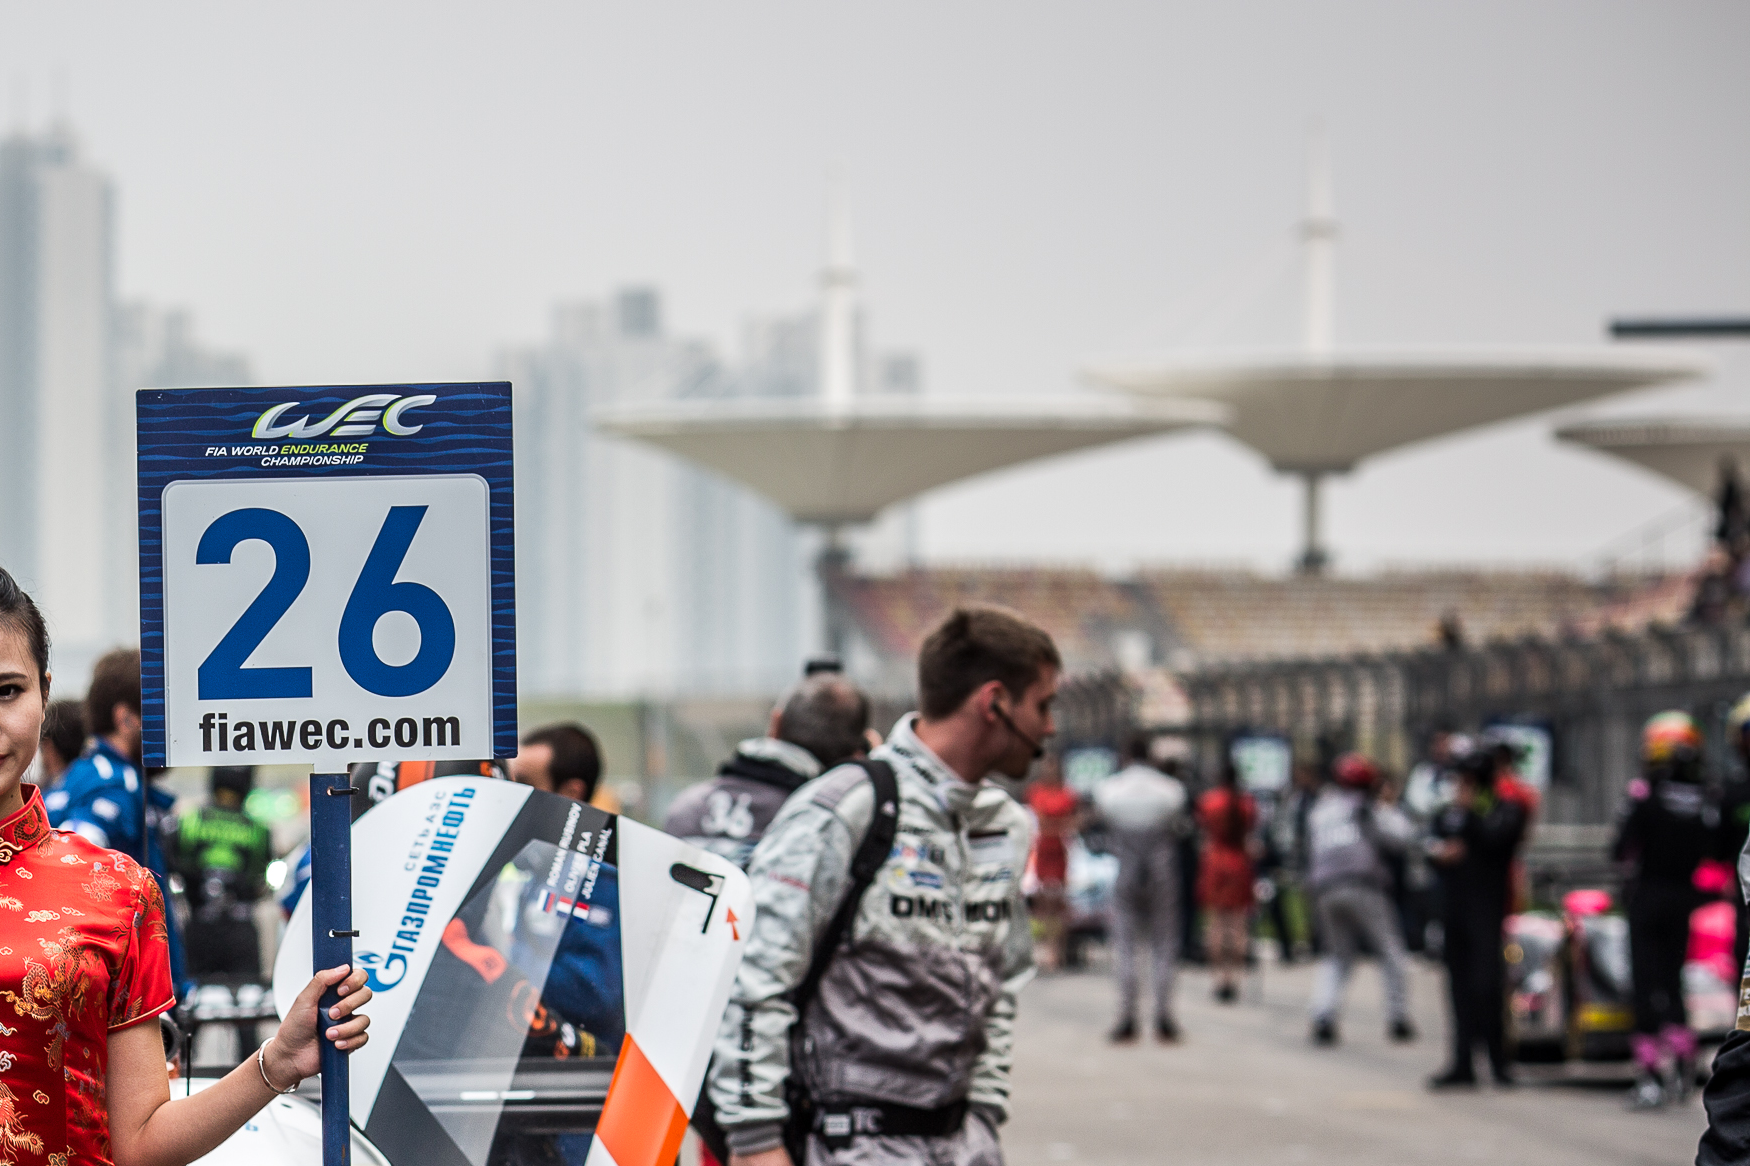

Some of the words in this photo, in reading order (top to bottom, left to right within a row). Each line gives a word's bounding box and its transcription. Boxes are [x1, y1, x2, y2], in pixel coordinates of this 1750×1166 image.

[251, 393, 437, 438] WEC
[205, 446, 228, 457] FIA
[231, 445, 279, 456] WORLD
[280, 443, 369, 454] ENDURANCE
[261, 455, 364, 466] CHAMPIONSHIP
[195, 504, 456, 701] 26
[198, 713, 461, 752] fiawec.com
[546, 848, 569, 887] ROMAN
[558, 802, 582, 850] RUSINOV
[576, 831, 592, 853] PLA
[392, 786, 476, 952] ГАЗПРОМНЕФТЬ
